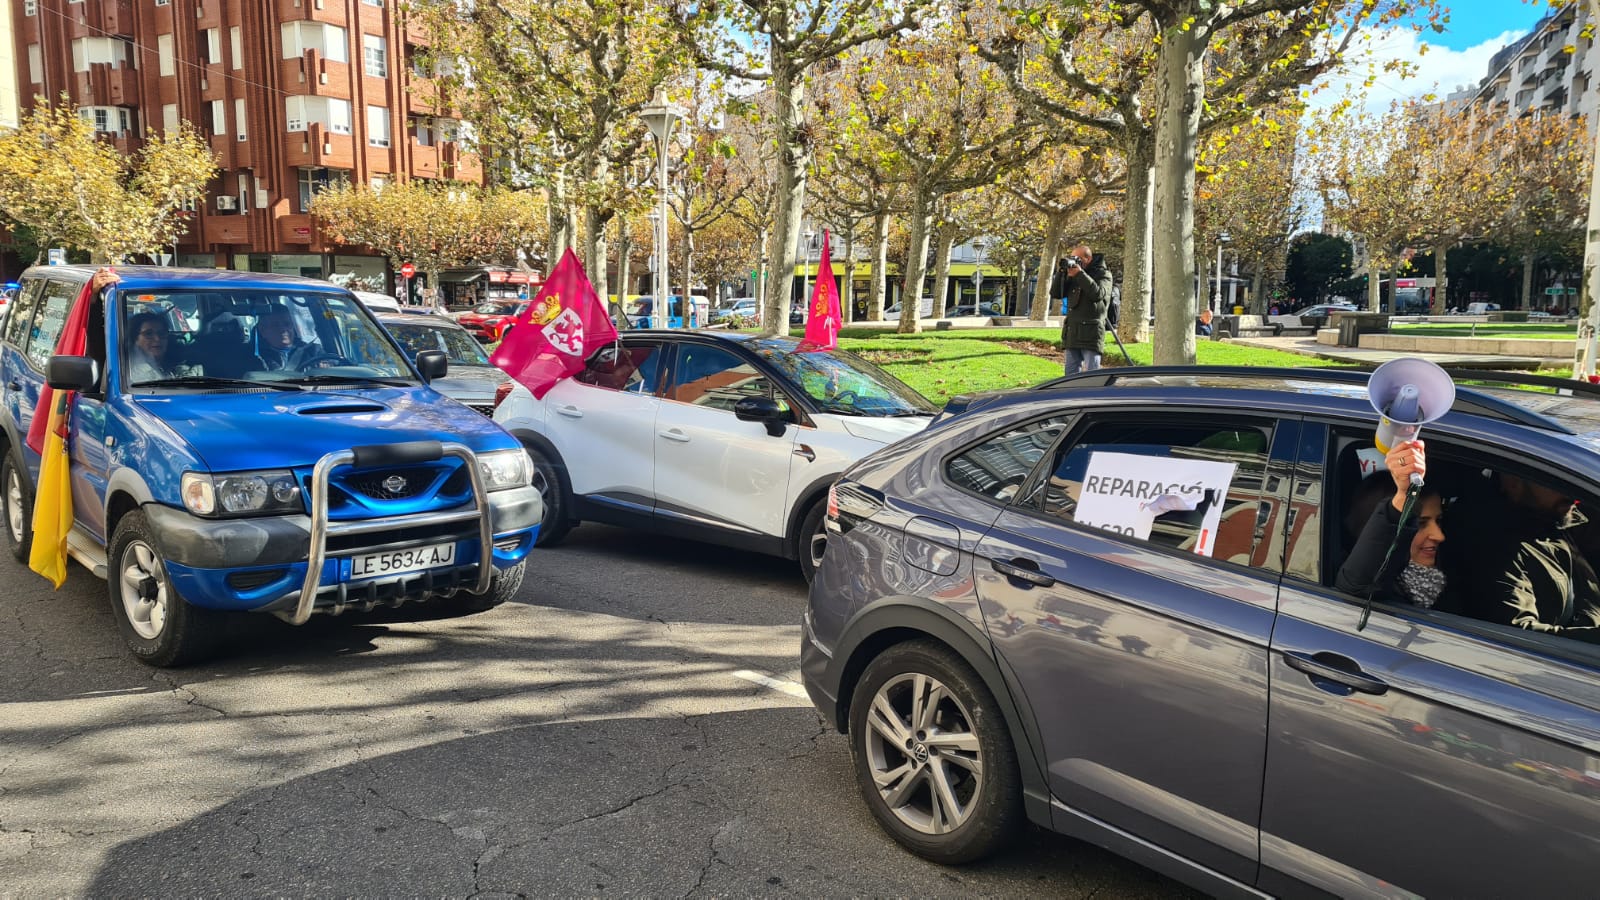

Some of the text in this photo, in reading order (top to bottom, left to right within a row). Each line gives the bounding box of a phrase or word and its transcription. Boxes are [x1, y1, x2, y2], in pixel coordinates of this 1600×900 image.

[352, 545, 453, 576] LE 5634 AJ
